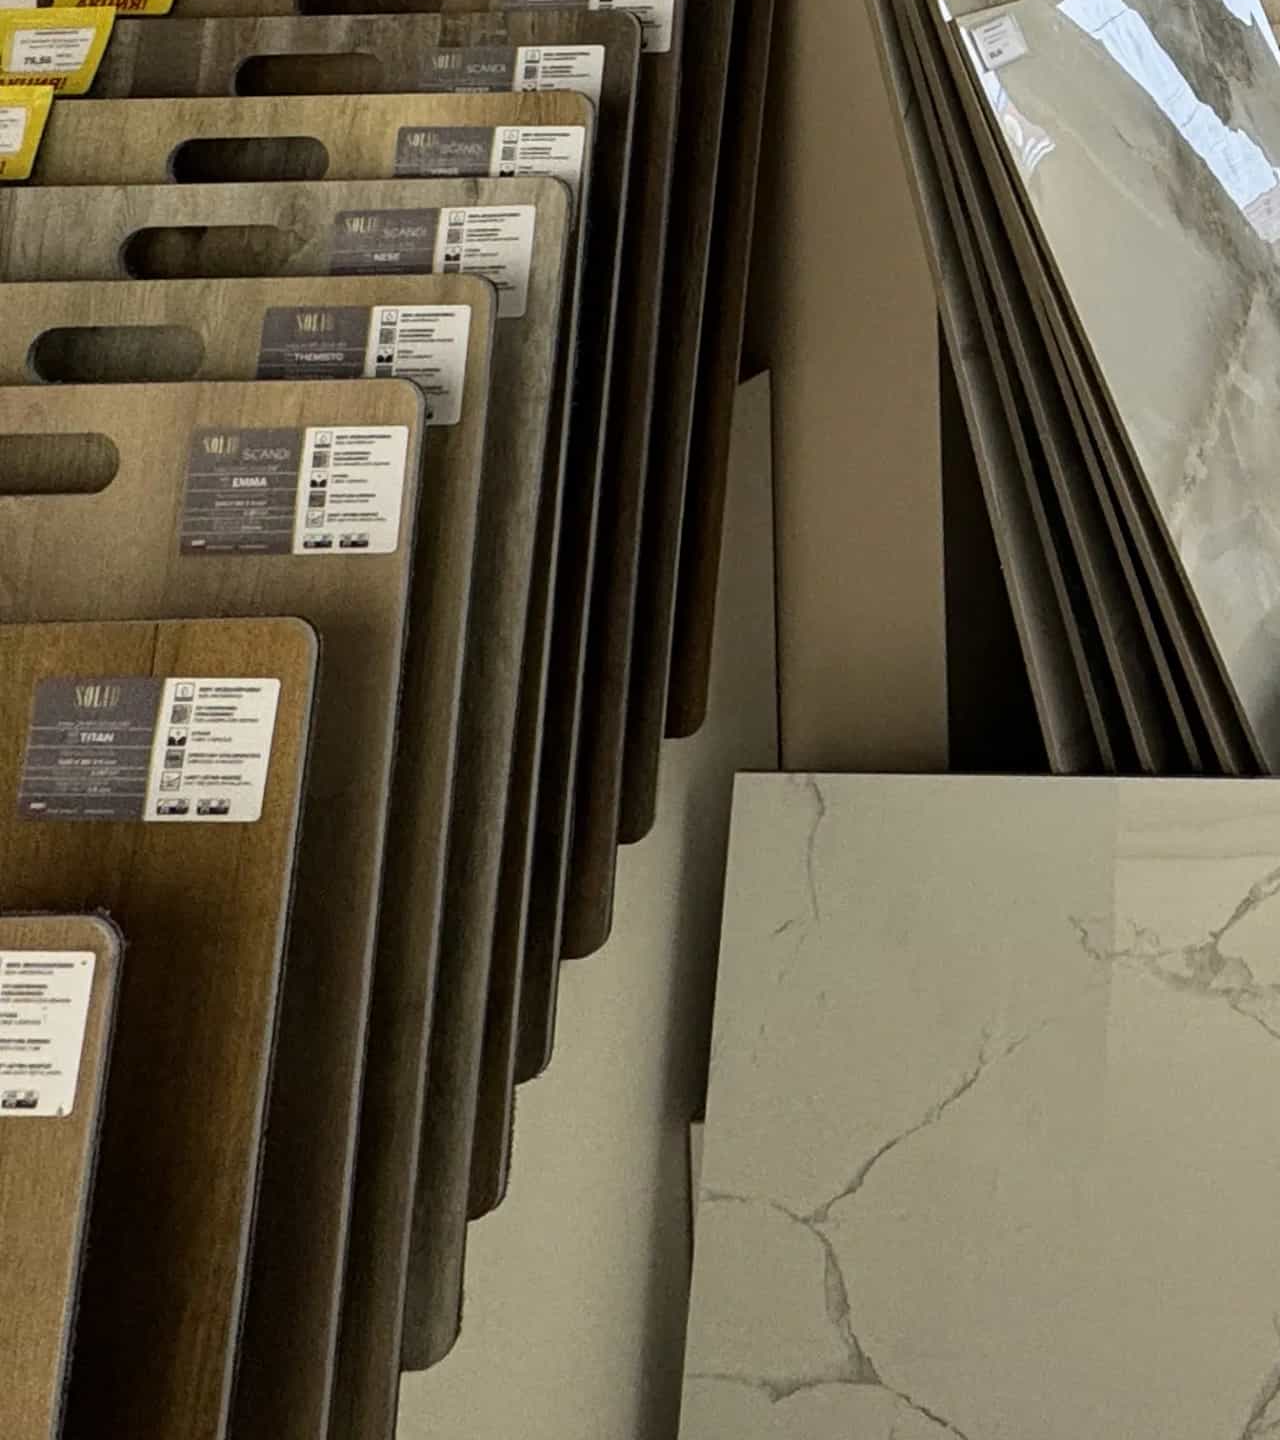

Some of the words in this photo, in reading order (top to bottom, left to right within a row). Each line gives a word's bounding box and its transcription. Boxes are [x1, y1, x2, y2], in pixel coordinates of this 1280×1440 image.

[242, 448, 291, 461] SCANDI
[232, 476, 268, 488] EMMA
[79, 732, 115, 743] TITAN
